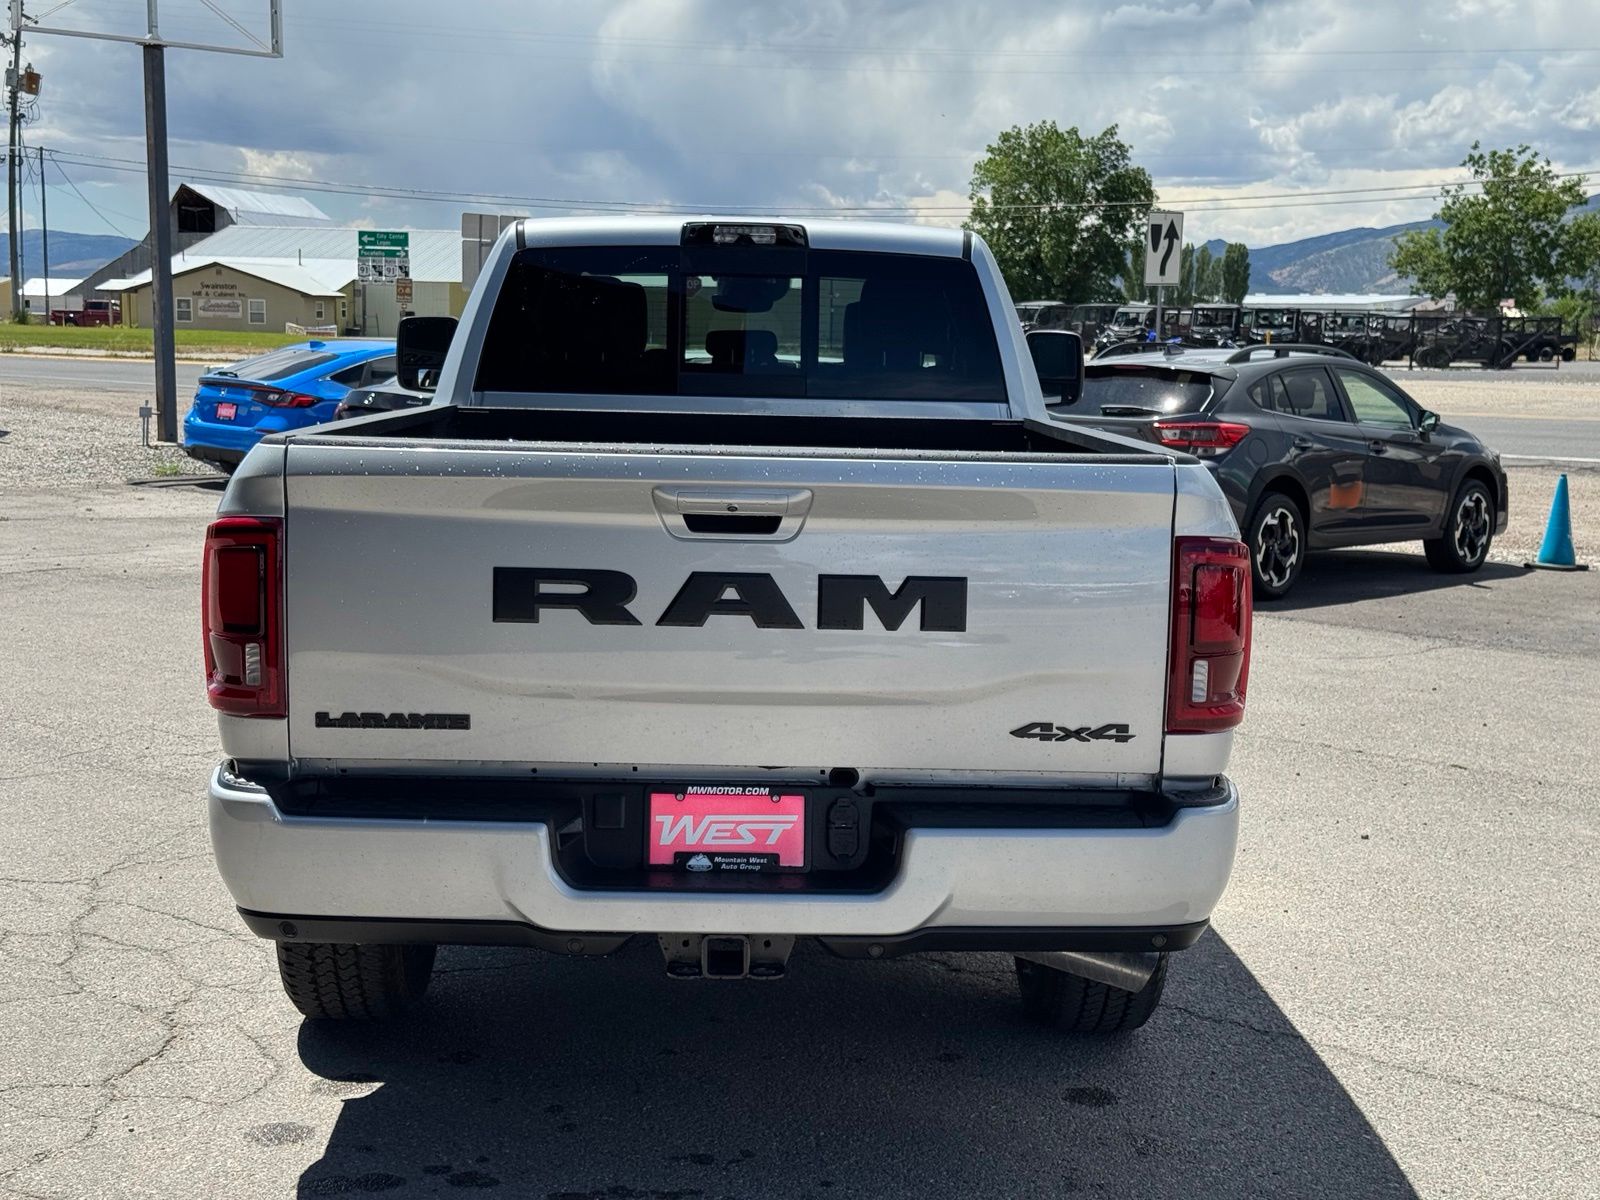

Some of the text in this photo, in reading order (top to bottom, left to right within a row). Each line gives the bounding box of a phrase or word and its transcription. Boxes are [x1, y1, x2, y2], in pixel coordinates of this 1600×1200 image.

[359, 266, 369, 274] 91
[386, 266, 396, 275] 91
[200, 281, 238, 290] Swainston
[493, 566, 969, 632] RAM
[315, 712, 470, 730] LARAMIE
[1009, 722, 1136, 743] 4x4
[686, 786, 770, 796] MWMOTOR.COM
[655, 814, 799, 845] WEST
[739, 863, 761, 871] Group
